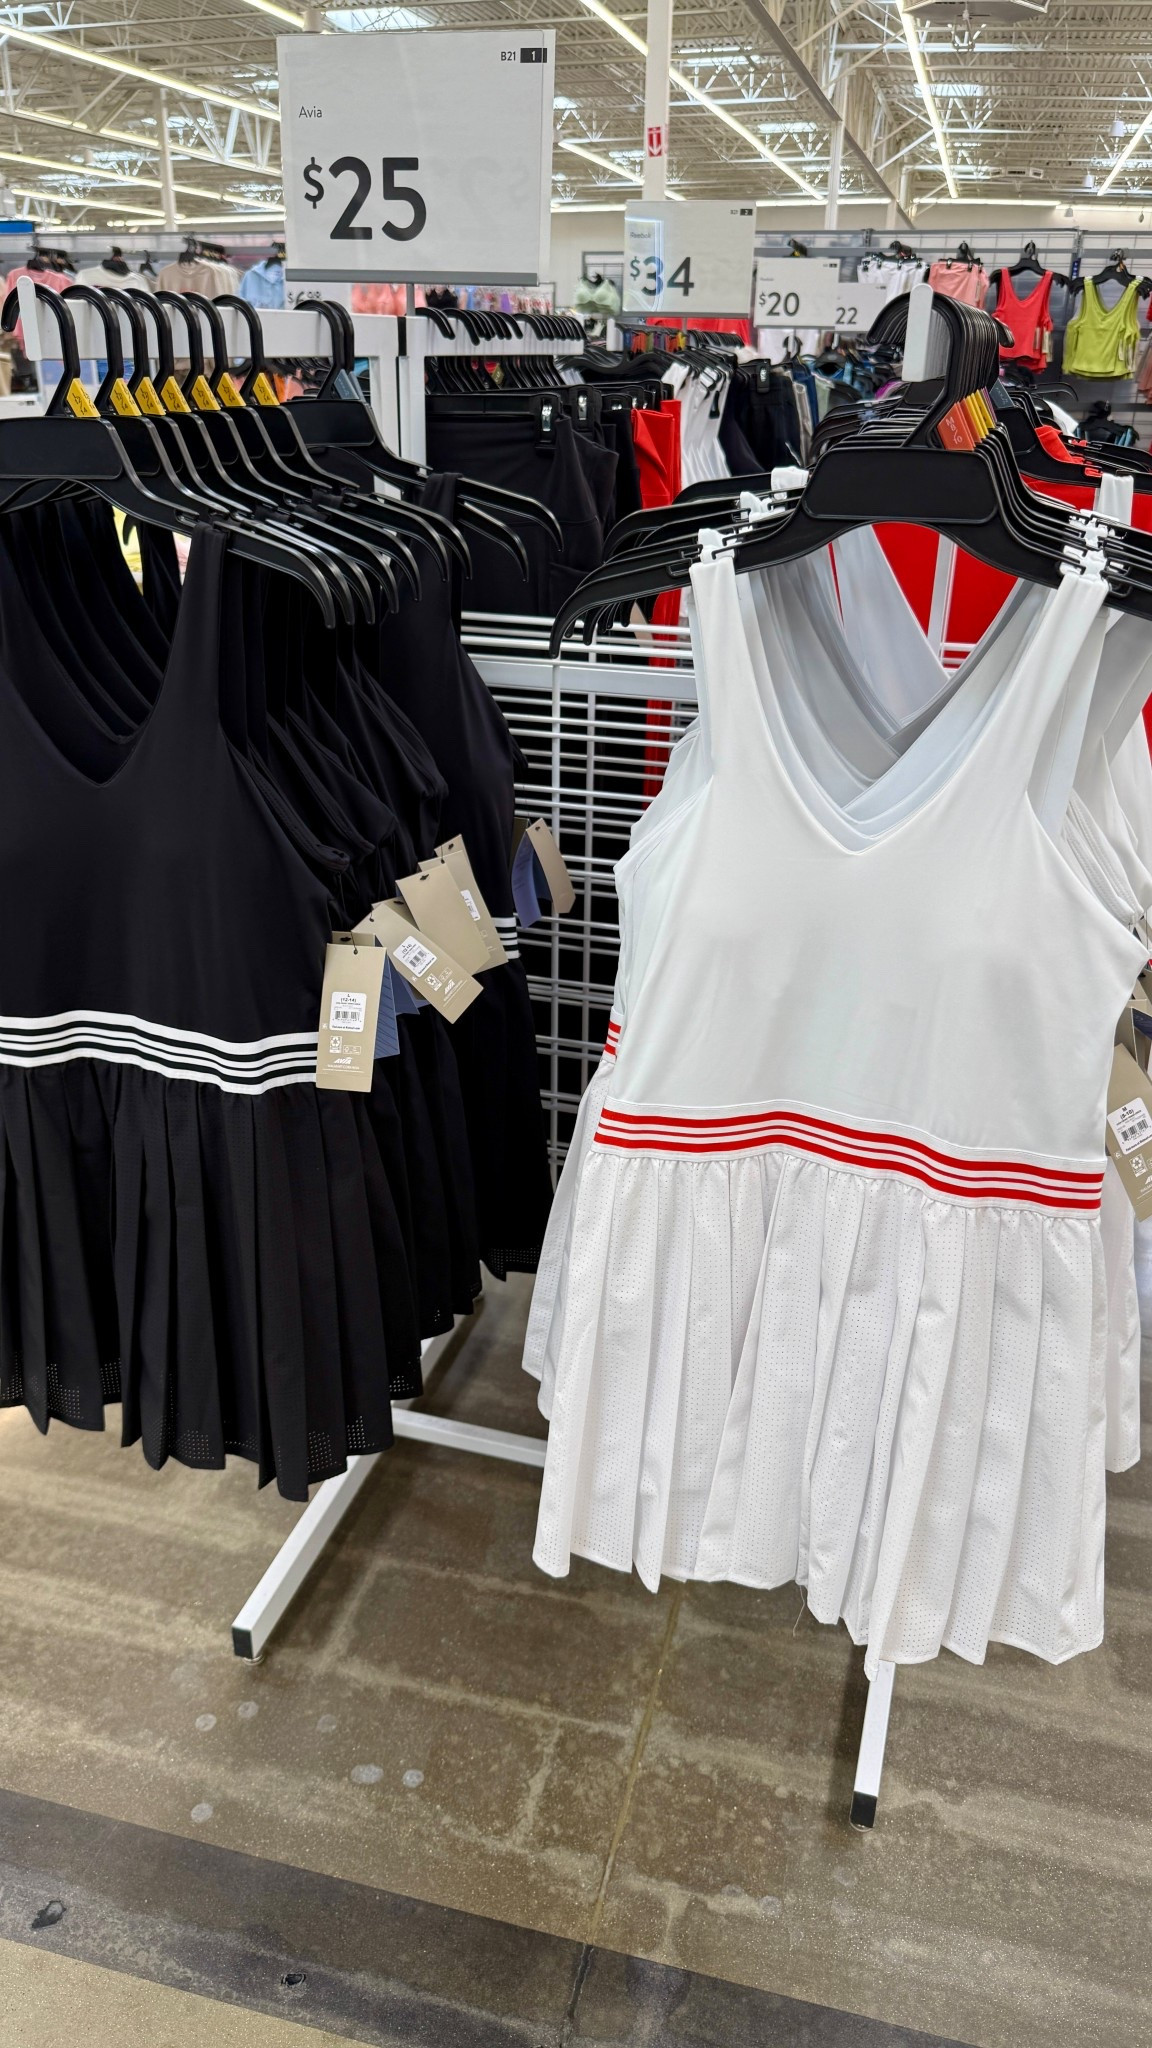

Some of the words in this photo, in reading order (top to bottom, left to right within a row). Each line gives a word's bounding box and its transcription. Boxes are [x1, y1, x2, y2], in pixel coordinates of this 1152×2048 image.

[500, 51, 516, 61] B21
[531, 51, 536, 61] 1
[299, 106, 323, 118] Avia
[303, 156, 427, 241] $25
[630, 256, 695, 297] $34
[759, 291, 800, 317] $20
